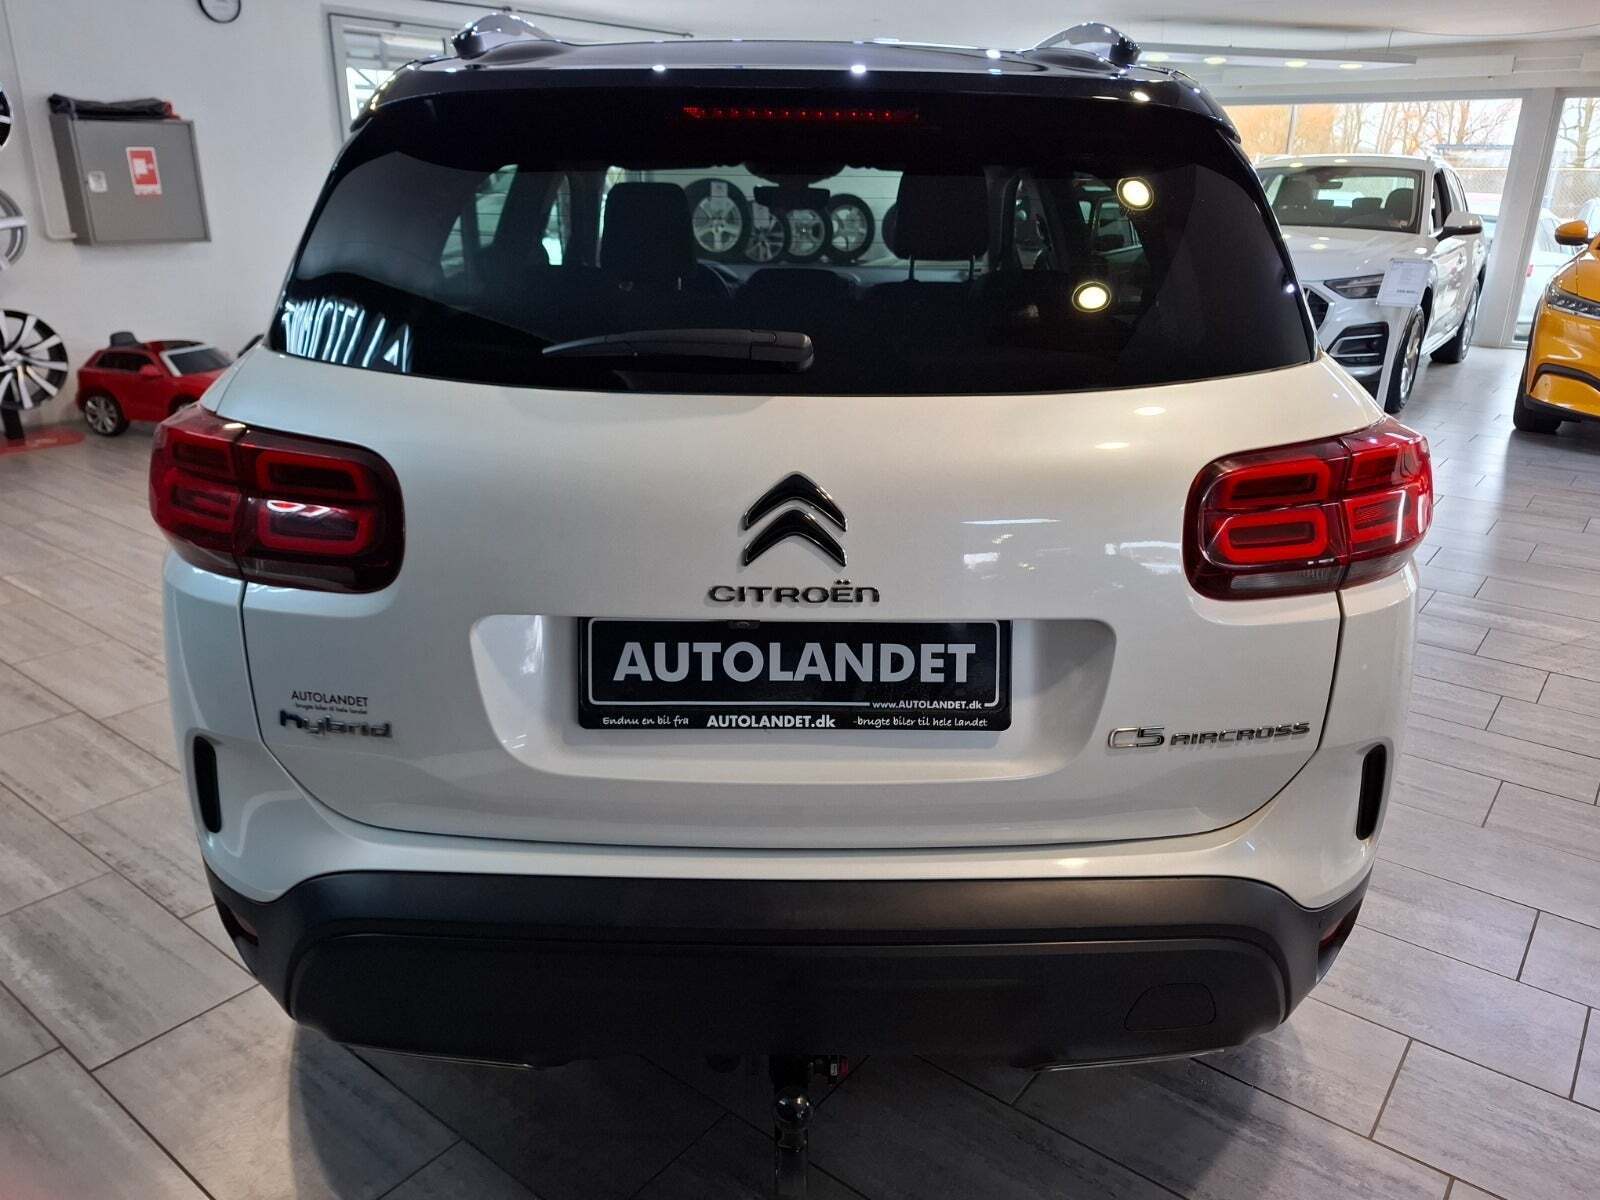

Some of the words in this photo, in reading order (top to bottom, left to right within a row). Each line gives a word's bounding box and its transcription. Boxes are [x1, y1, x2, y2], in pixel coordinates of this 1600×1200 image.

[612, 641, 977, 683] AUTOLANDET
[291, 690, 369, 707] AUTOLANDET
[872, 699, 983, 710] www.AUTOLANDET.dk
[602, 716, 640, 725] Endnu
[657, 715, 672, 725] bil
[673, 715, 689, 727] fra
[706, 714, 837, 729] AUTOLANDET.dk
[892, 716, 916, 726] biler
[917, 717, 931, 726] til
[932, 717, 952, 726] hele
[954, 717, 989, 727] landet
[1107, 727, 1165, 748] C5
[1170, 722, 1311, 746] AIRCROSS
